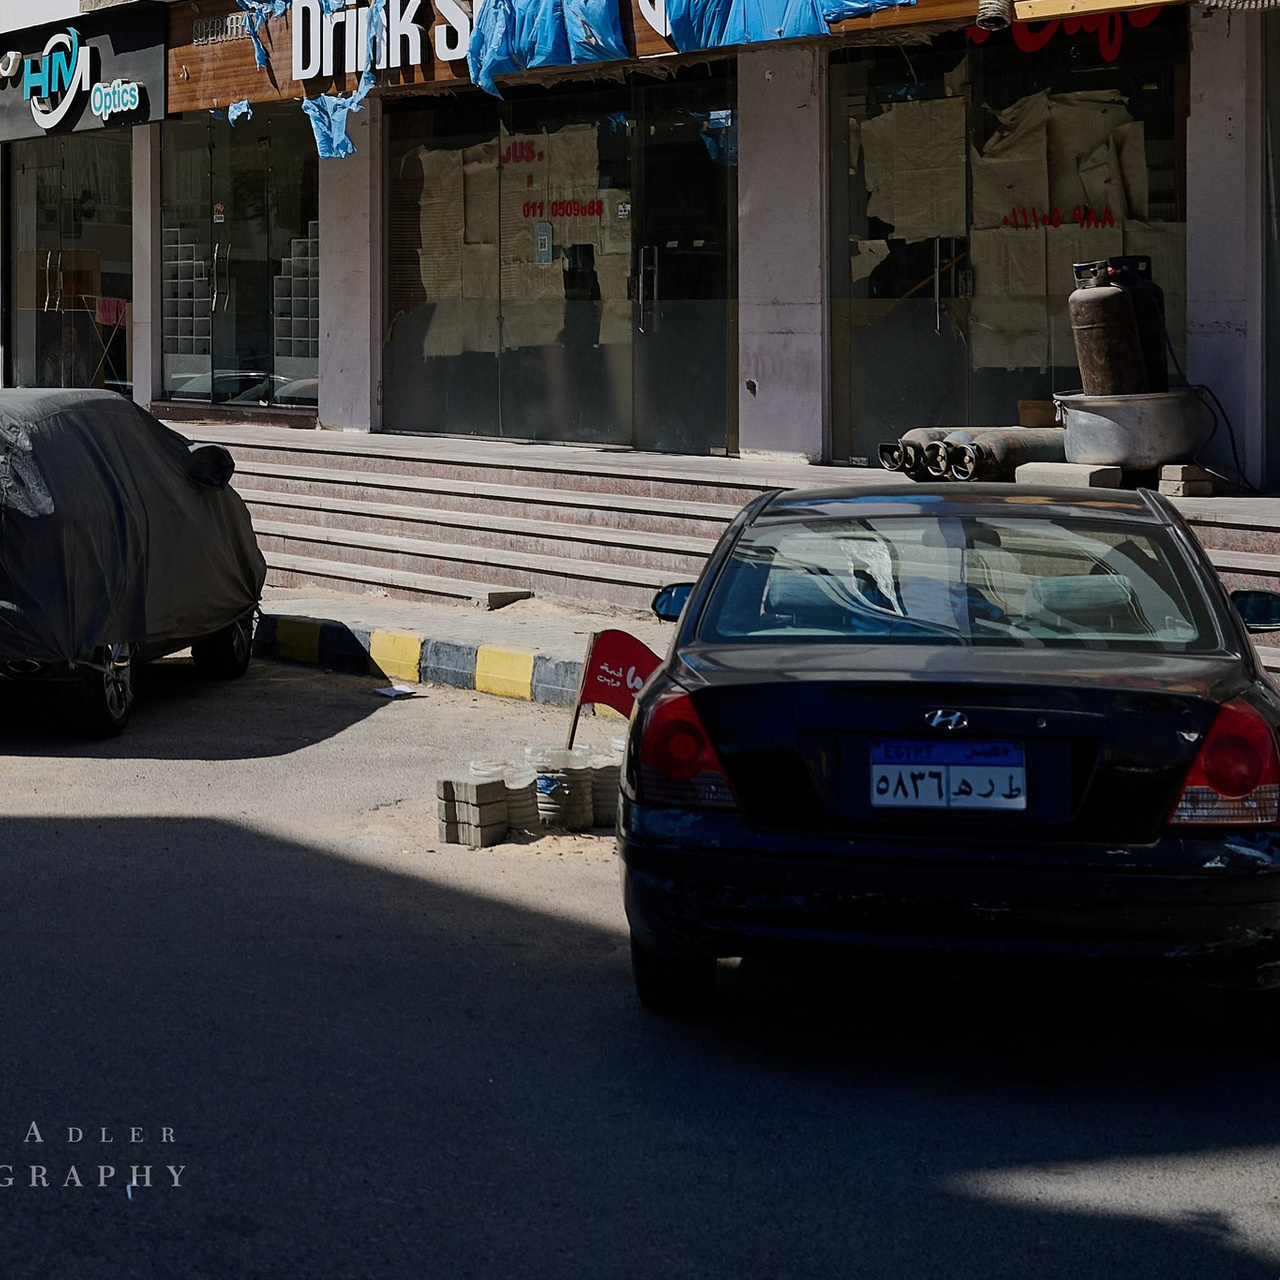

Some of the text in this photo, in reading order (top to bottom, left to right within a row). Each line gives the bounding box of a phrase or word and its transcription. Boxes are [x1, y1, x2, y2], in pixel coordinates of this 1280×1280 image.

[91, 80, 139, 120] Optics
[884, 744, 934, 760] EGYPT
[876, 771, 944, 800] ٥٨٣٦
